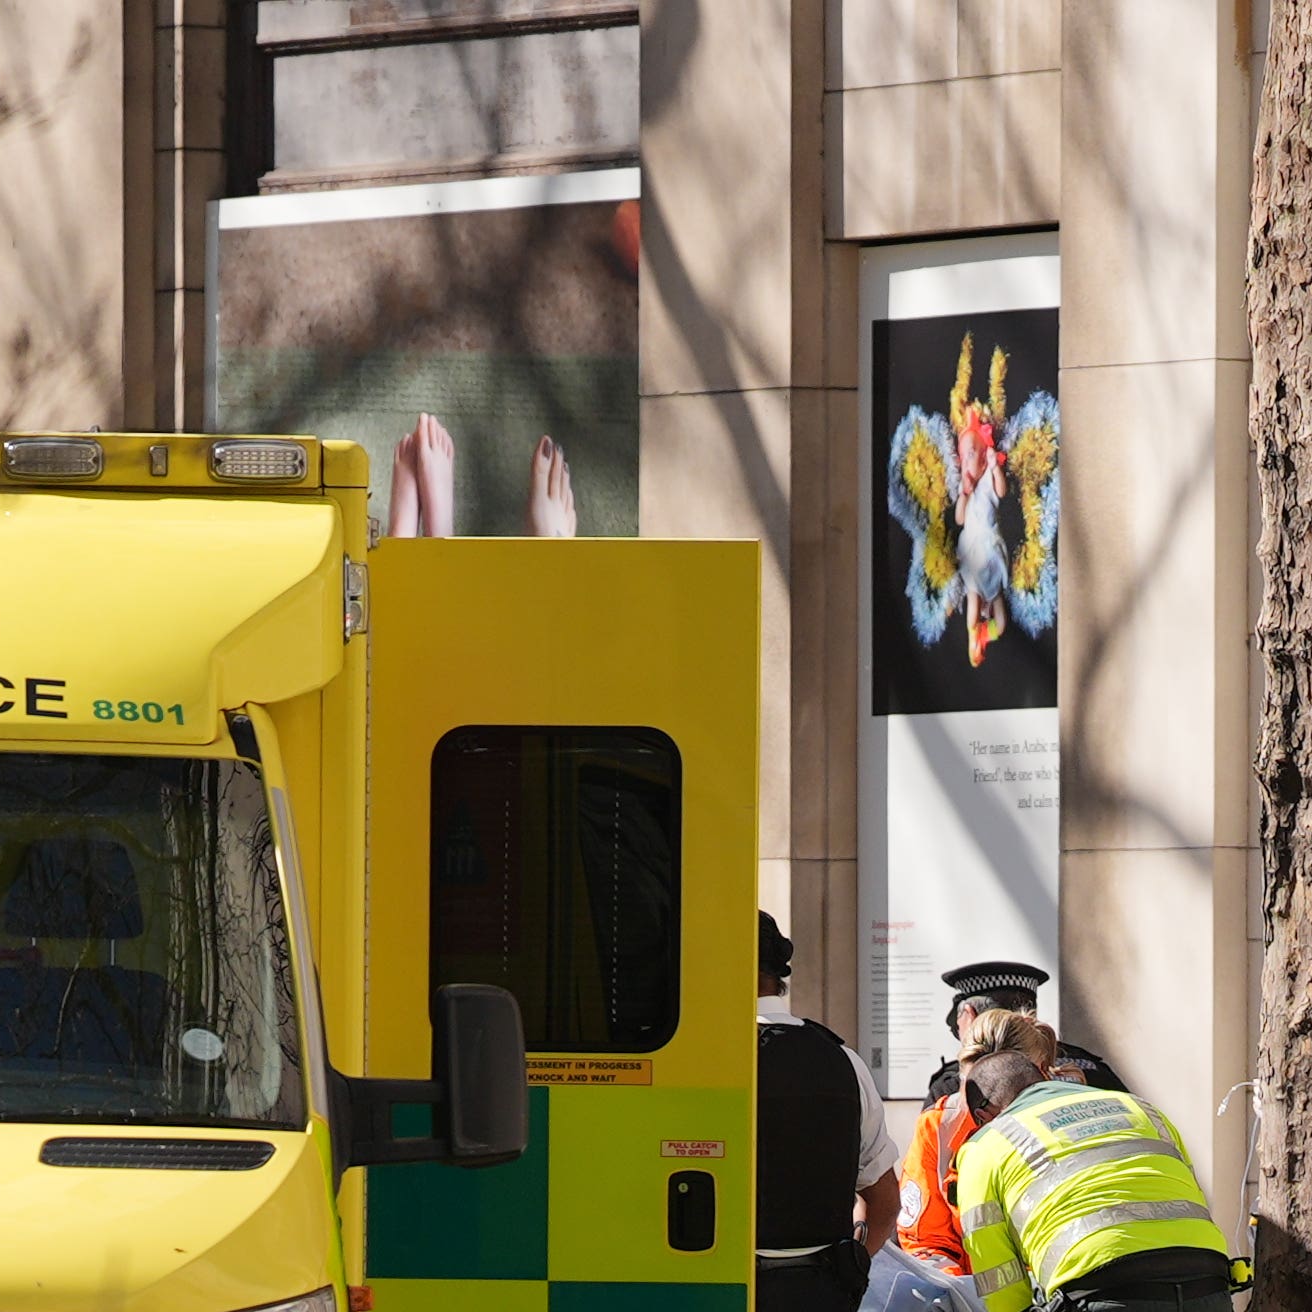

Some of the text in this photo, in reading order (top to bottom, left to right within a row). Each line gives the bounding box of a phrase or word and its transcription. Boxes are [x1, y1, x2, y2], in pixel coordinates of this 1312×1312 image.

[92, 699, 186, 726] 8801
[589, 1062, 642, 1070] PROGRESS
[1048, 1104, 1128, 1131] AMBULANCE
[1052, 1100, 1106, 1117] LONDON
